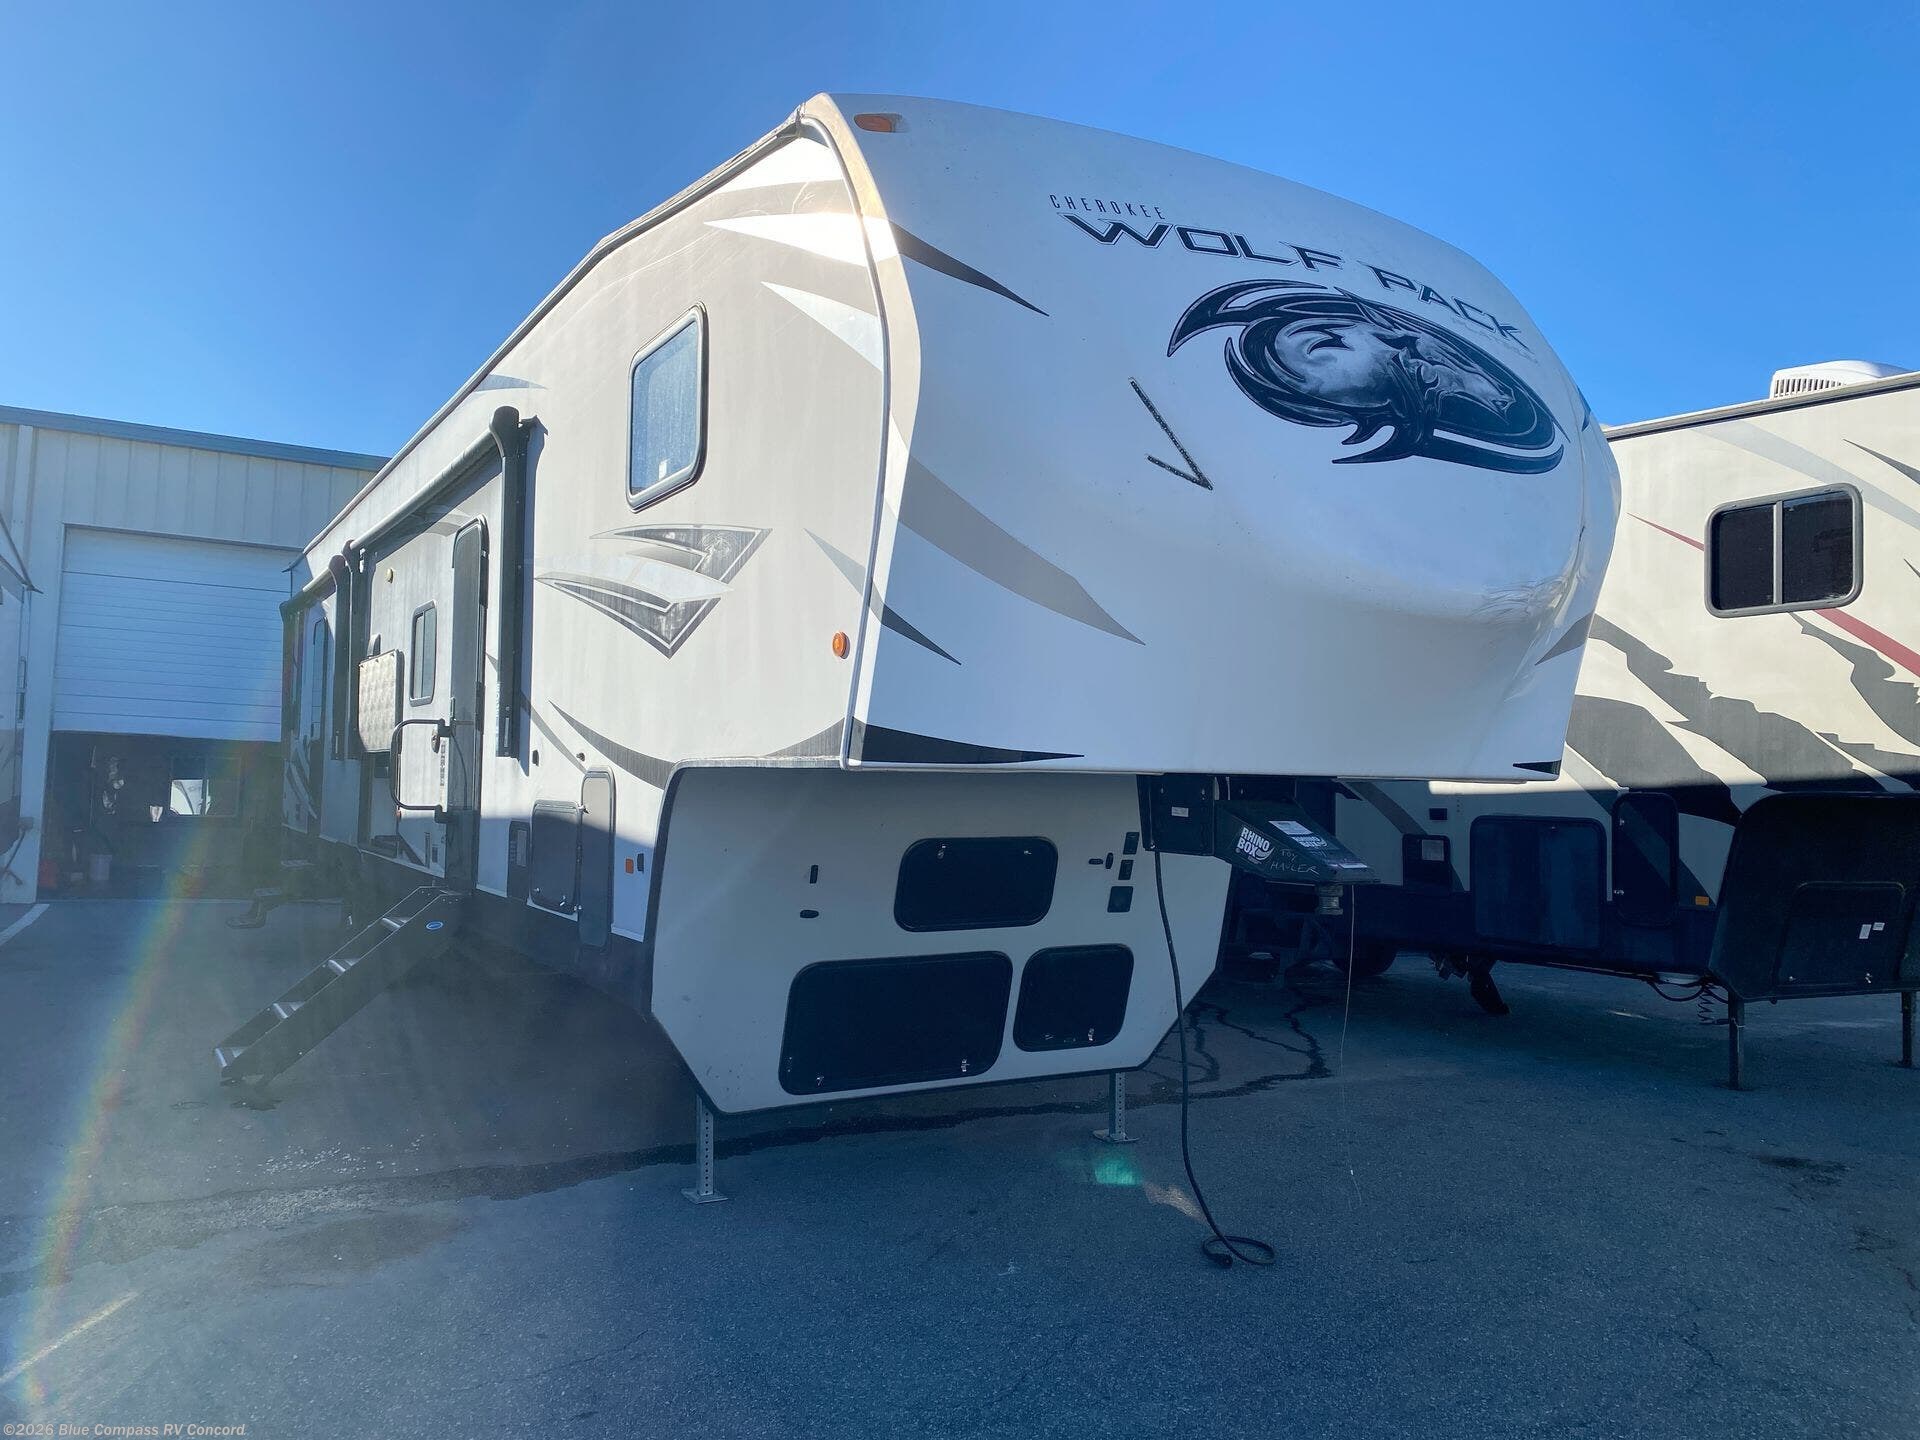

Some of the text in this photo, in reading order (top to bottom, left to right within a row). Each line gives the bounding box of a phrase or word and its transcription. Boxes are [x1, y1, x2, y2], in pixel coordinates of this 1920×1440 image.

[1049, 194, 1166, 220] CHEROKEE
[1057, 211, 1343, 271] WOLF
[1358, 259, 1533, 354] PACK
[1237, 837, 1258, 857] BOX
[1241, 827, 1270, 852] RHINO
